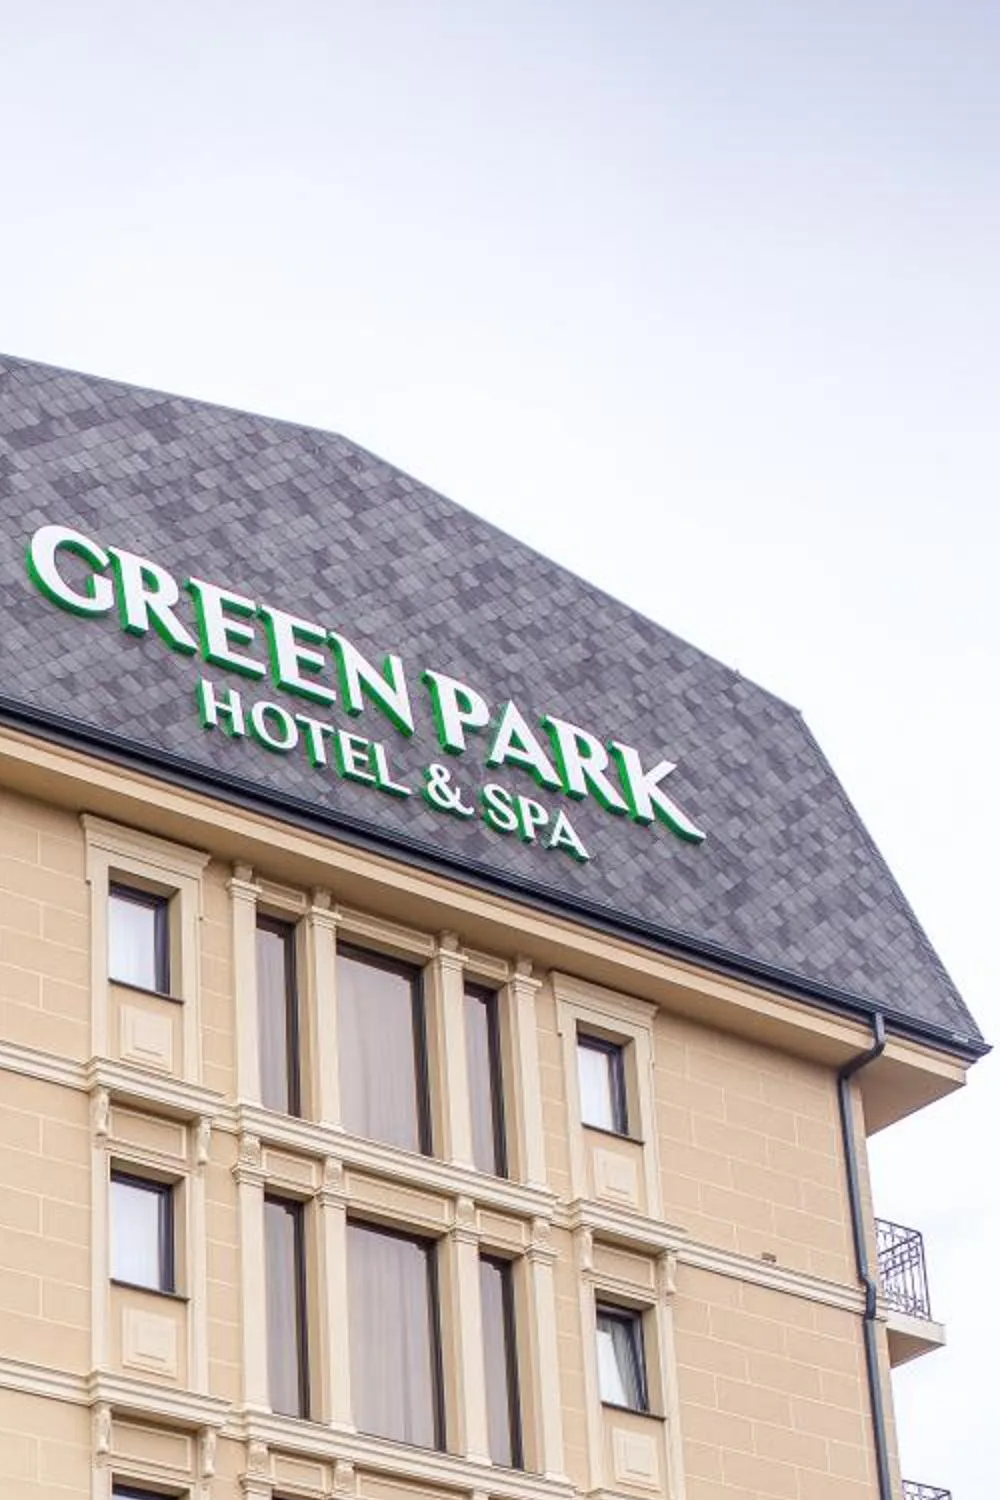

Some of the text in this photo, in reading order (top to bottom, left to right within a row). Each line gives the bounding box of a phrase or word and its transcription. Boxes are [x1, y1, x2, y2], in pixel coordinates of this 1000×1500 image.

[27, 525, 705, 842] GREEN PARK
[199, 678, 589, 862] HOTEL & SPA
